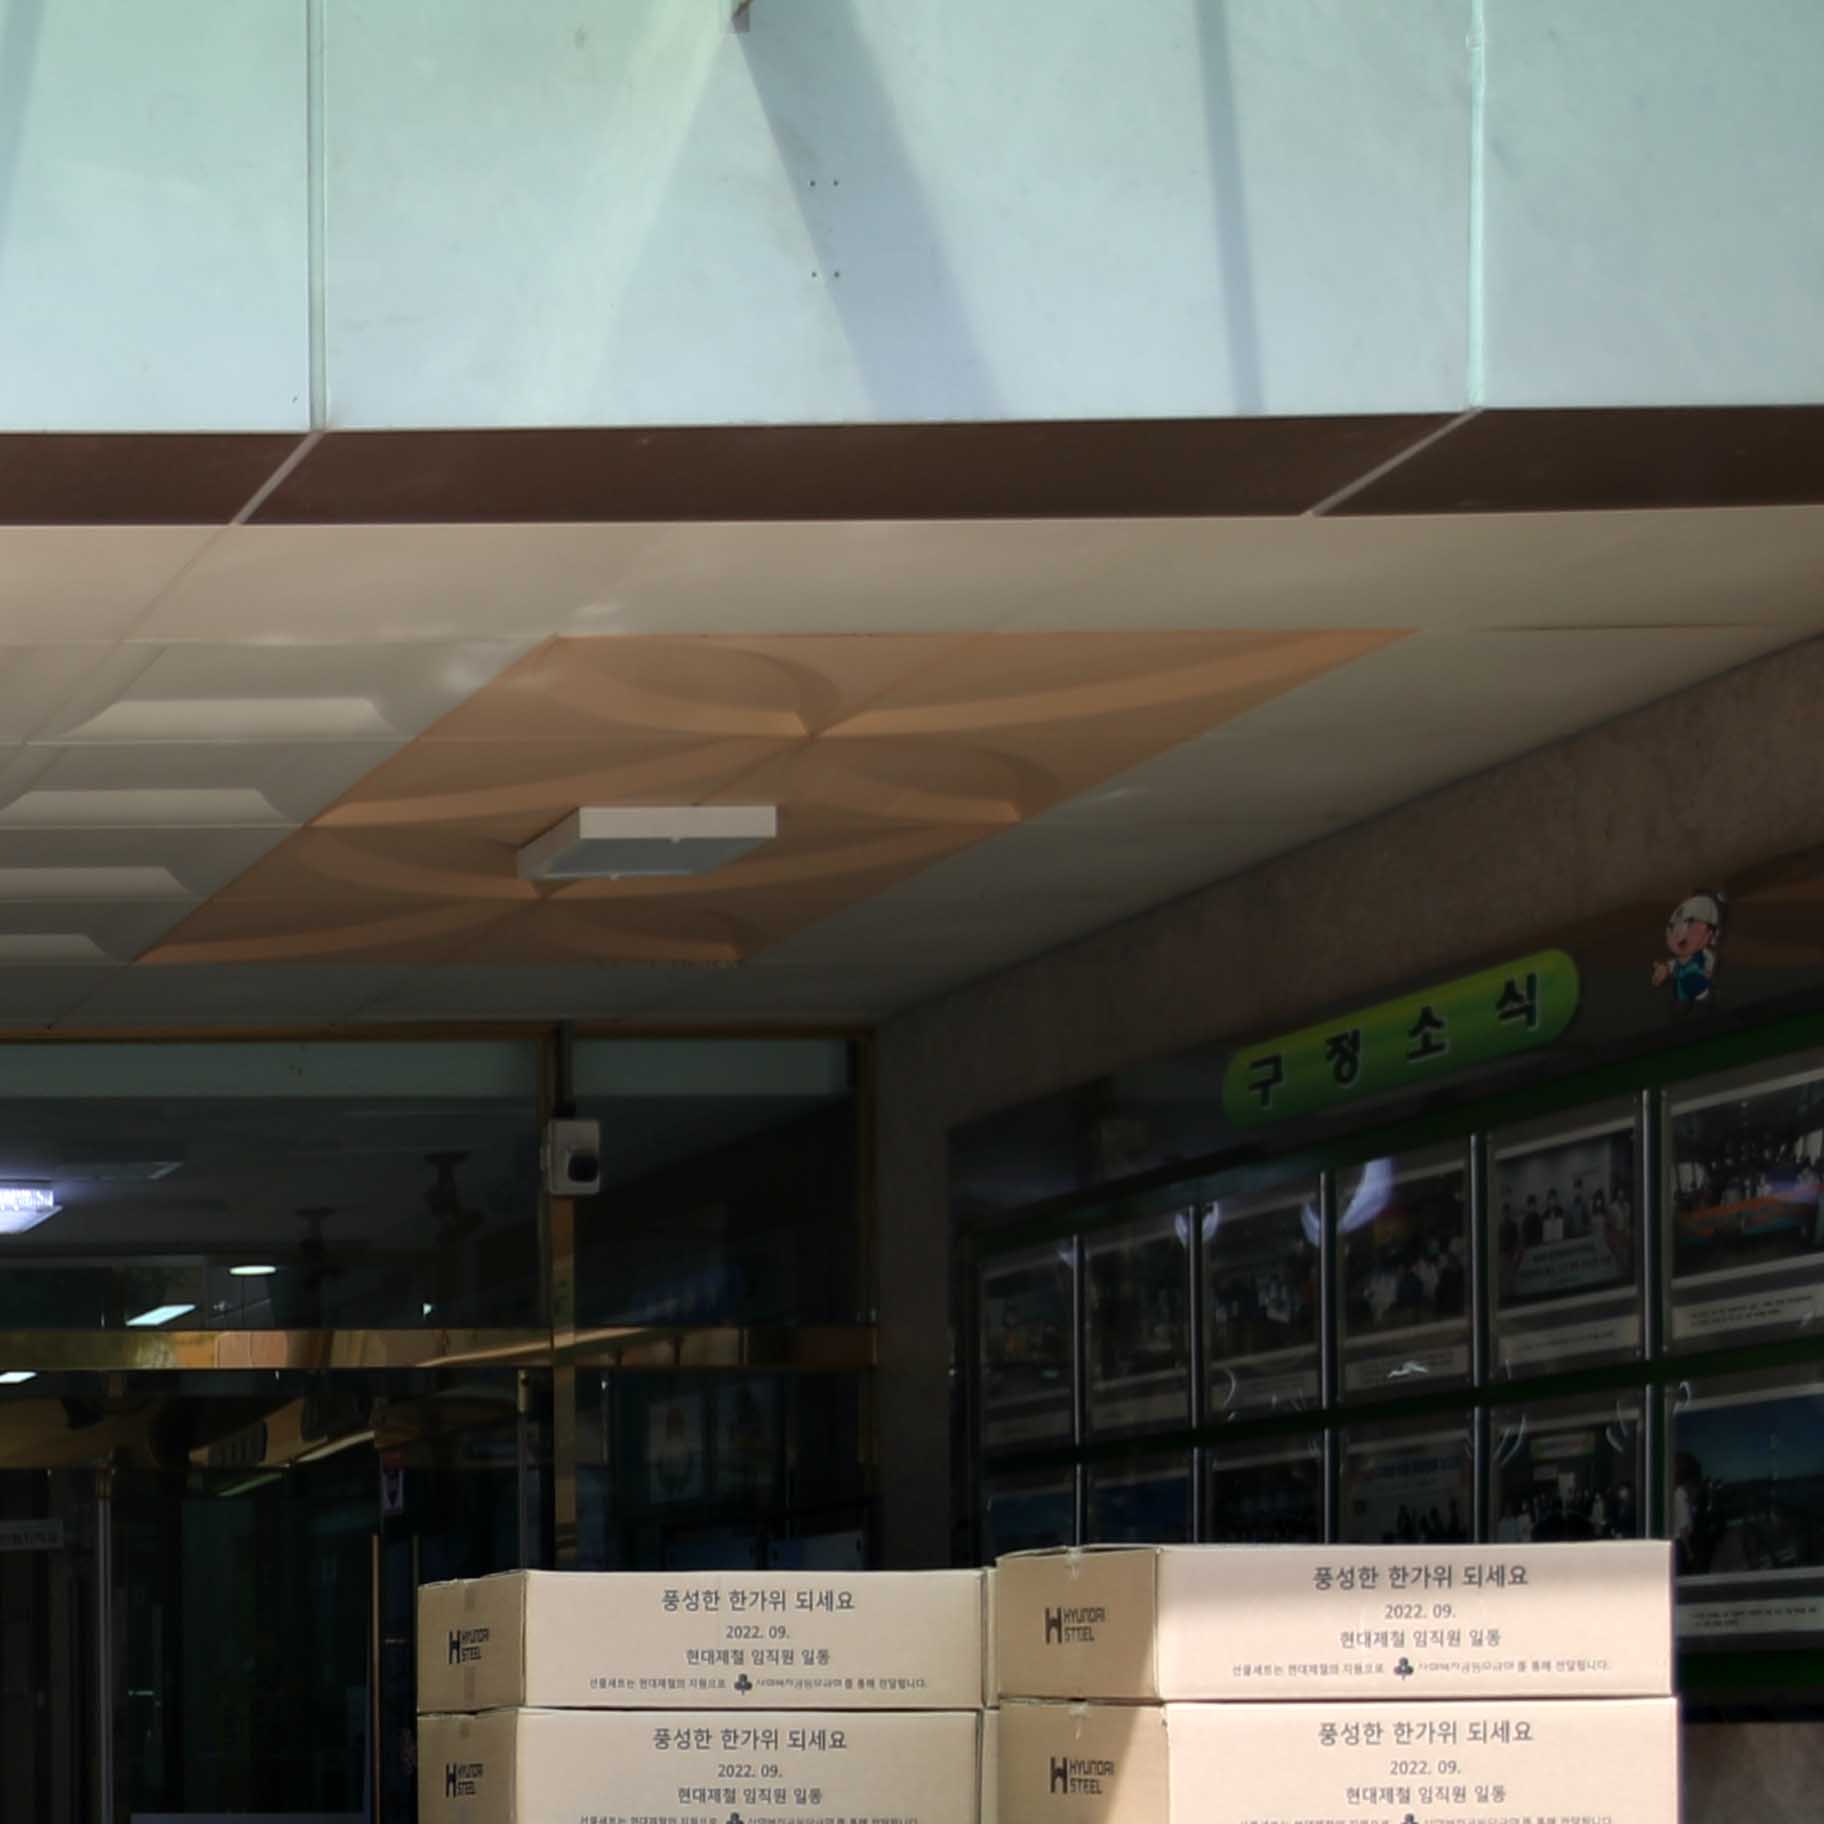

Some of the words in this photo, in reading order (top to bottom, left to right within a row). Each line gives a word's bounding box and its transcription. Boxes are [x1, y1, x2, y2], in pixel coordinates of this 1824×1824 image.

[1248, 972, 1539, 1107] 구정소식
[662, 1588, 722, 1612] 풍성한
[728, 1589, 786, 1612] 한가위
[795, 1589, 855, 1612] 되세요
[1319, 1721, 1384, 1746] 풍성한
[1392, 1720, 1457, 1745] 한가위
[1467, 1720, 1533, 1744] 되세요
[1390, 1760, 1432, 1776] 2022.
[1438, 1760, 1461, 1775] 09.
[1346, 1786, 1411, 1805] 현대제철
[1418, 1785, 1466, 1804] 임직원
[1474, 1785, 1506, 1803] 일동
